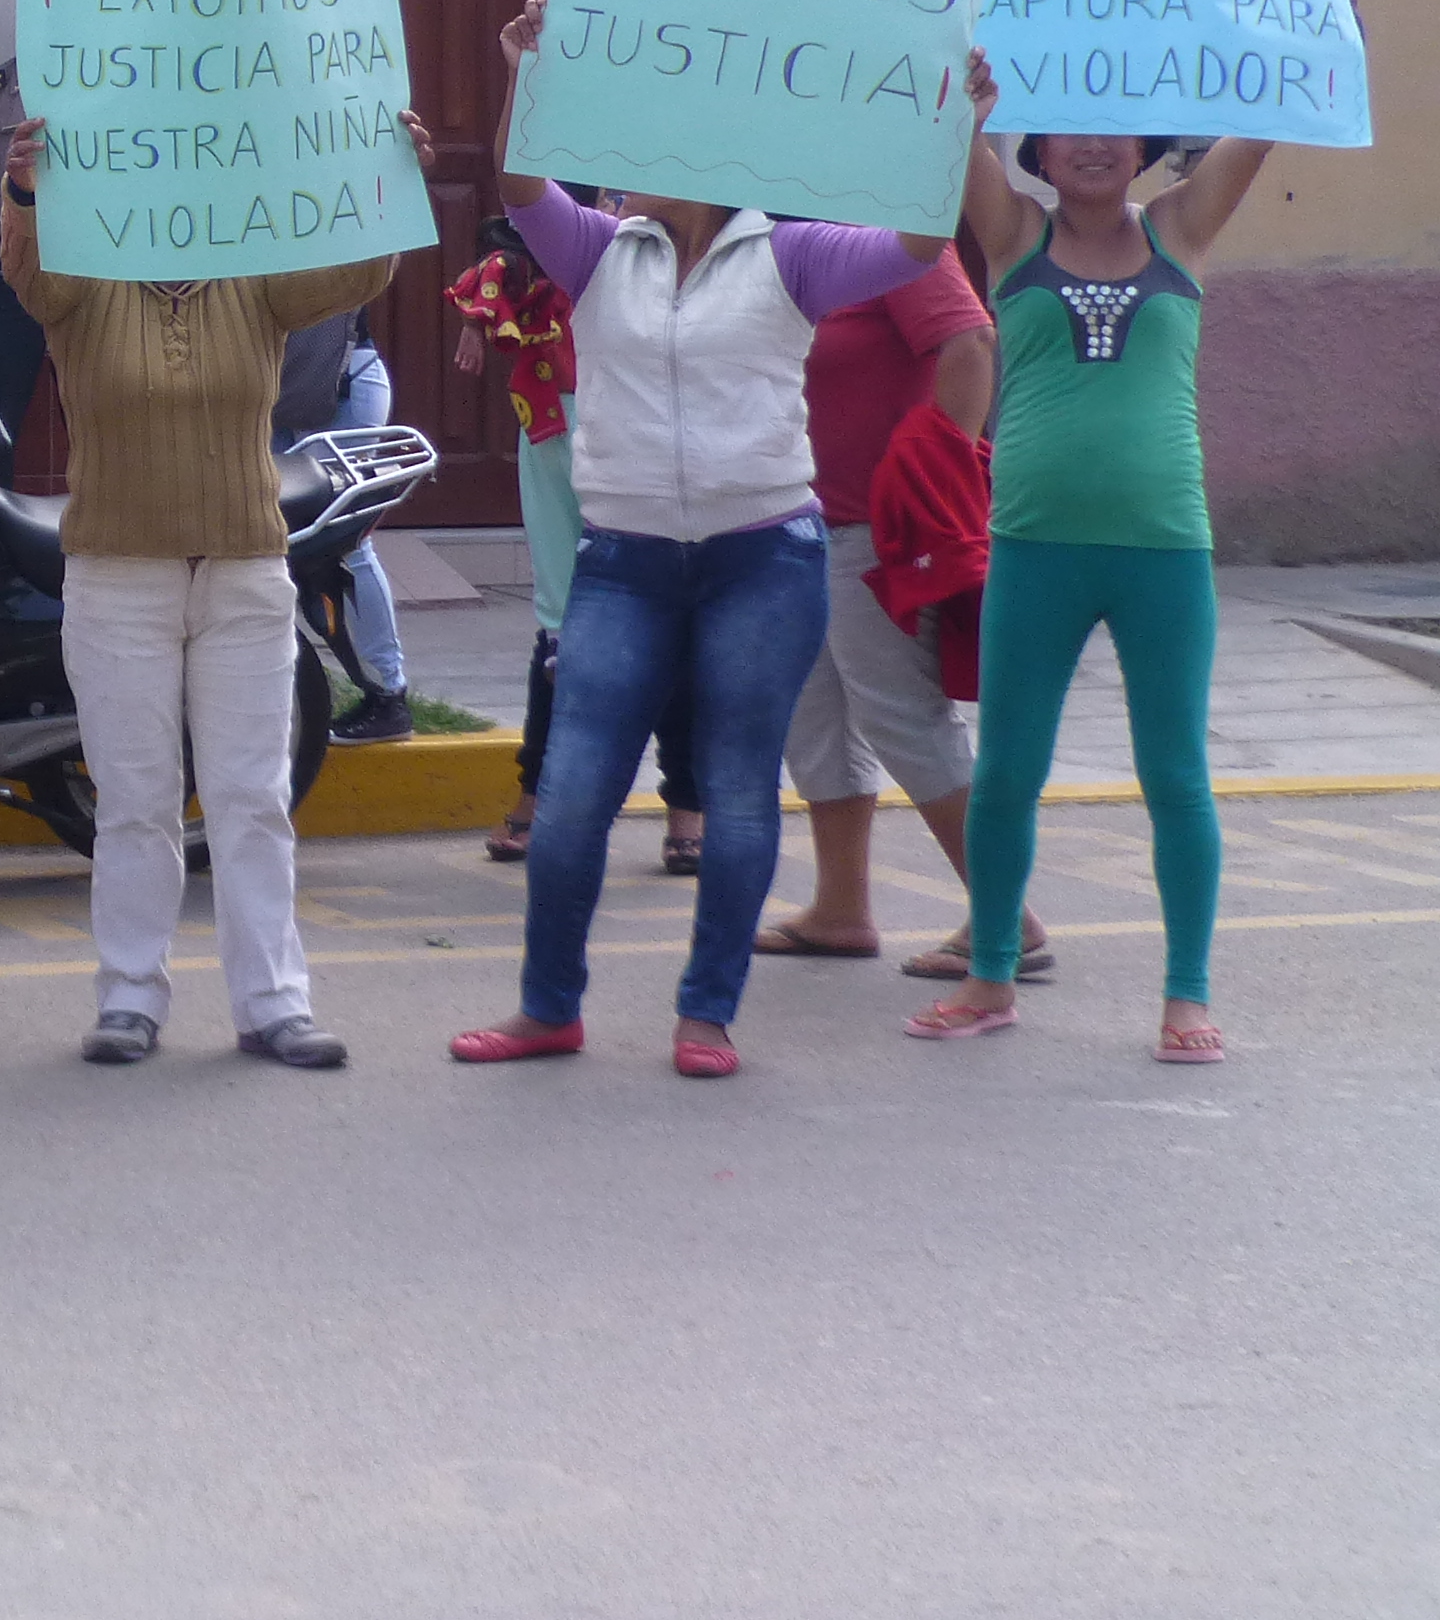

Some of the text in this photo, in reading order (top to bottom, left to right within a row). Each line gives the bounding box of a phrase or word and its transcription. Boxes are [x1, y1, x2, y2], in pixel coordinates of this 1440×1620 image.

[42, 26, 394, 93] JUSTICIA PARA
[560, 6, 950, 124] JUSTICIA!
[1010, 45, 1335, 112] VIOLADOR!
[44, 95, 396, 172] NUESTRA NIÑA
[95, 176, 383, 249] VIOLADA!
